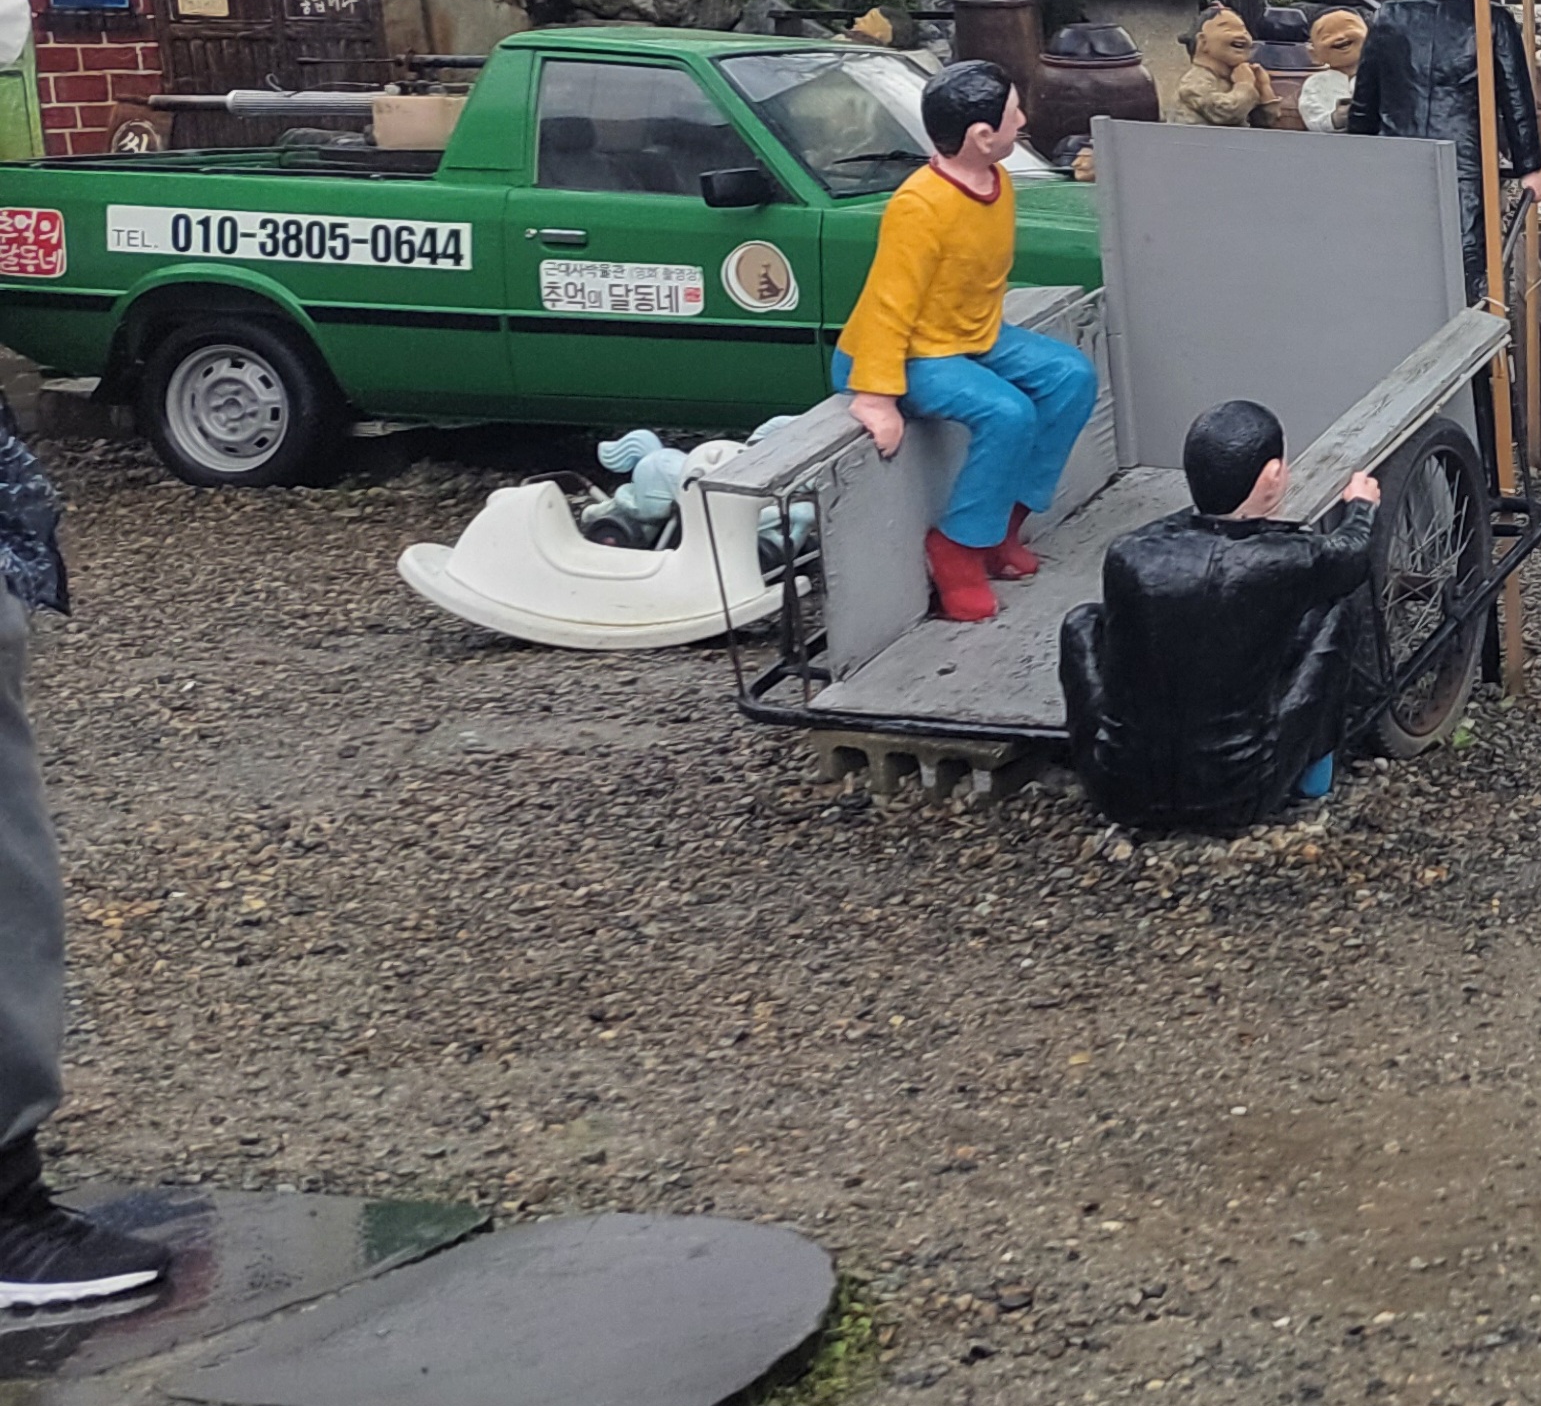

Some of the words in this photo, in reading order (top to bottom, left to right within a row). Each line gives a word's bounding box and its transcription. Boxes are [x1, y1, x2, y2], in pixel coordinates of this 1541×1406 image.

[112, 228, 159, 249] TEL.
[171, 212, 464, 268] 010-3805-0644
[543, 281, 603, 309] 추억의
[608, 283, 680, 313] 달동네
